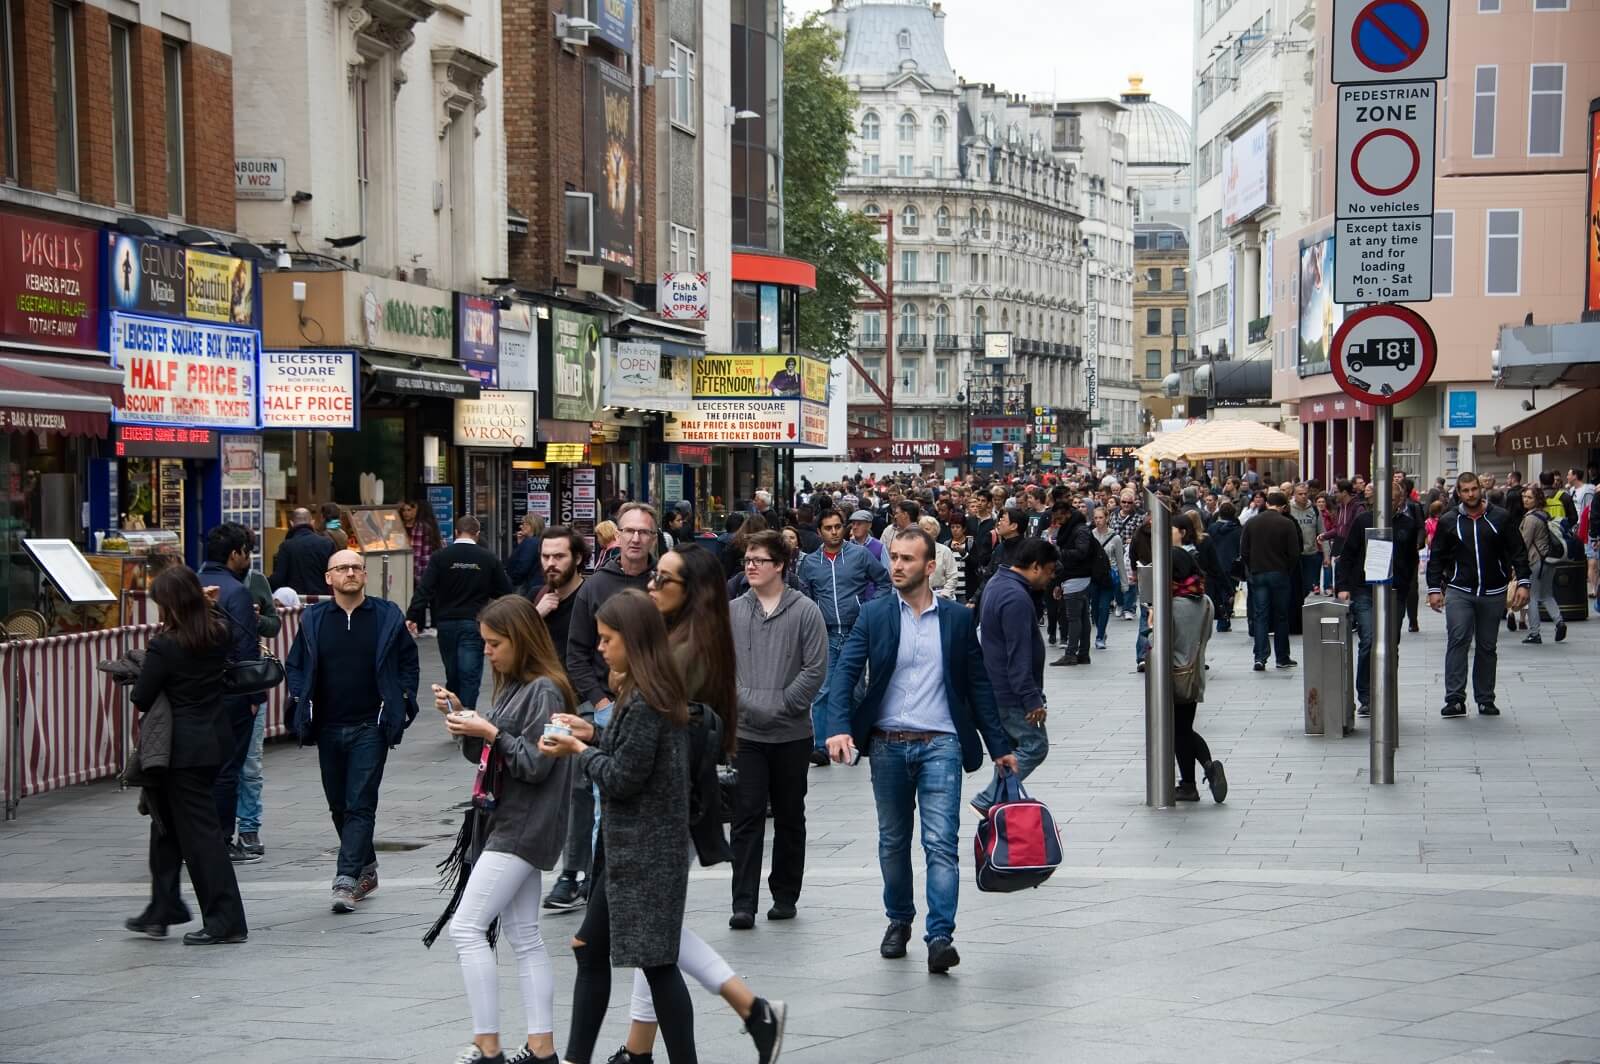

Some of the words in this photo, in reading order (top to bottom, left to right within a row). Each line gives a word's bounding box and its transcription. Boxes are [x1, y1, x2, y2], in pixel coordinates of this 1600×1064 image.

[1345, 88, 1429, 101] PEDESTRIAN
[1356, 104, 1416, 122] ZONE
[248, 175, 271, 186] WC2
[1349, 203, 1365, 213] No
[1370, 202, 1420, 213] vehicles
[1346, 222, 1388, 234] Except
[1392, 221, 1421, 232] taxis
[1349, 236, 1361, 246] at
[1366, 238, 1387, 247] any
[1392, 235, 1418, 245] time
[21, 228, 84, 272] BAGELS
[1361, 248, 1383, 258] and
[1387, 248, 1405, 258] for
[141, 242, 185, 280] GENIUS
[1361, 261, 1405, 272] loading
[25, 273, 53, 293] KEBABS
[54, 278, 60, 293] &
[60, 278, 80, 296] PIZZA
[188, 266, 229, 303] Beautiful
[1353, 275, 1378, 285] Mon
[1392, 273, 1413, 284] Sat
[673, 281, 690, 291] Fish
[691, 282, 697, 291] &
[1356, 288, 1364, 298] 6
[1377, 287, 1409, 297] 10am
[673, 292, 697, 303] Chips
[16, 294, 60, 315] VEGETARIAN
[28, 316, 38, 334] TO
[39, 318, 57, 335] TAKE
[57, 321, 78, 337] AWAY
[123, 322, 167, 353] LEICESTER
[171, 328, 203, 357] SQUARE
[207, 332, 222, 358] BOX
[225, 335, 252, 361] OFFICE
[1089, 324, 1097, 349] BOOK
[1376, 341, 1409, 360] 18t
[270, 354, 343, 364] LEICESTER
[620, 358, 656, 372] OPEN
[278, 366, 335, 376] SQUARE
[697, 359, 732, 376] SUNNY
[131, 357, 178, 391] HALF
[187, 362, 237, 396] PRICE
[266, 385, 290, 393] THE
[294, 385, 347, 393] OFFICIAL
[696, 376, 756, 395] AFTERNOON
[125, 394, 165, 413] SCOUNT
[172, 396, 210, 416] THEATRE
[216, 400, 249, 417] TICKETS
[263, 396, 302, 410] HALF
[308, 396, 352, 410] PRICE
[465, 404, 484, 413] THE
[487, 402, 519, 415] PLAY
[697, 402, 744, 411] LEICESTER
[748, 402, 785, 411] SQUARE
[11, 411, 26, 428] BAR
[27, 413, 33, 428] &
[34, 413, 66, 430] PIZZERIA
[264, 414, 306, 422] TICKET
[310, 414, 351, 422] BOOTH
[489, 415, 527, 427] GOES
[706, 412, 720, 420] THE
[723, 412, 756, 420] OFFICIAL
[681, 421, 701, 430] HALF
[704, 421, 728, 430] PRICE
[739, 421, 783, 430] DISCOUNT
[683, 432, 718, 440] THEATRE
[721, 432, 750, 440] TICKET
[753, 432, 781, 440] BOOTH
[1511, 433, 1568, 450] BELLA
